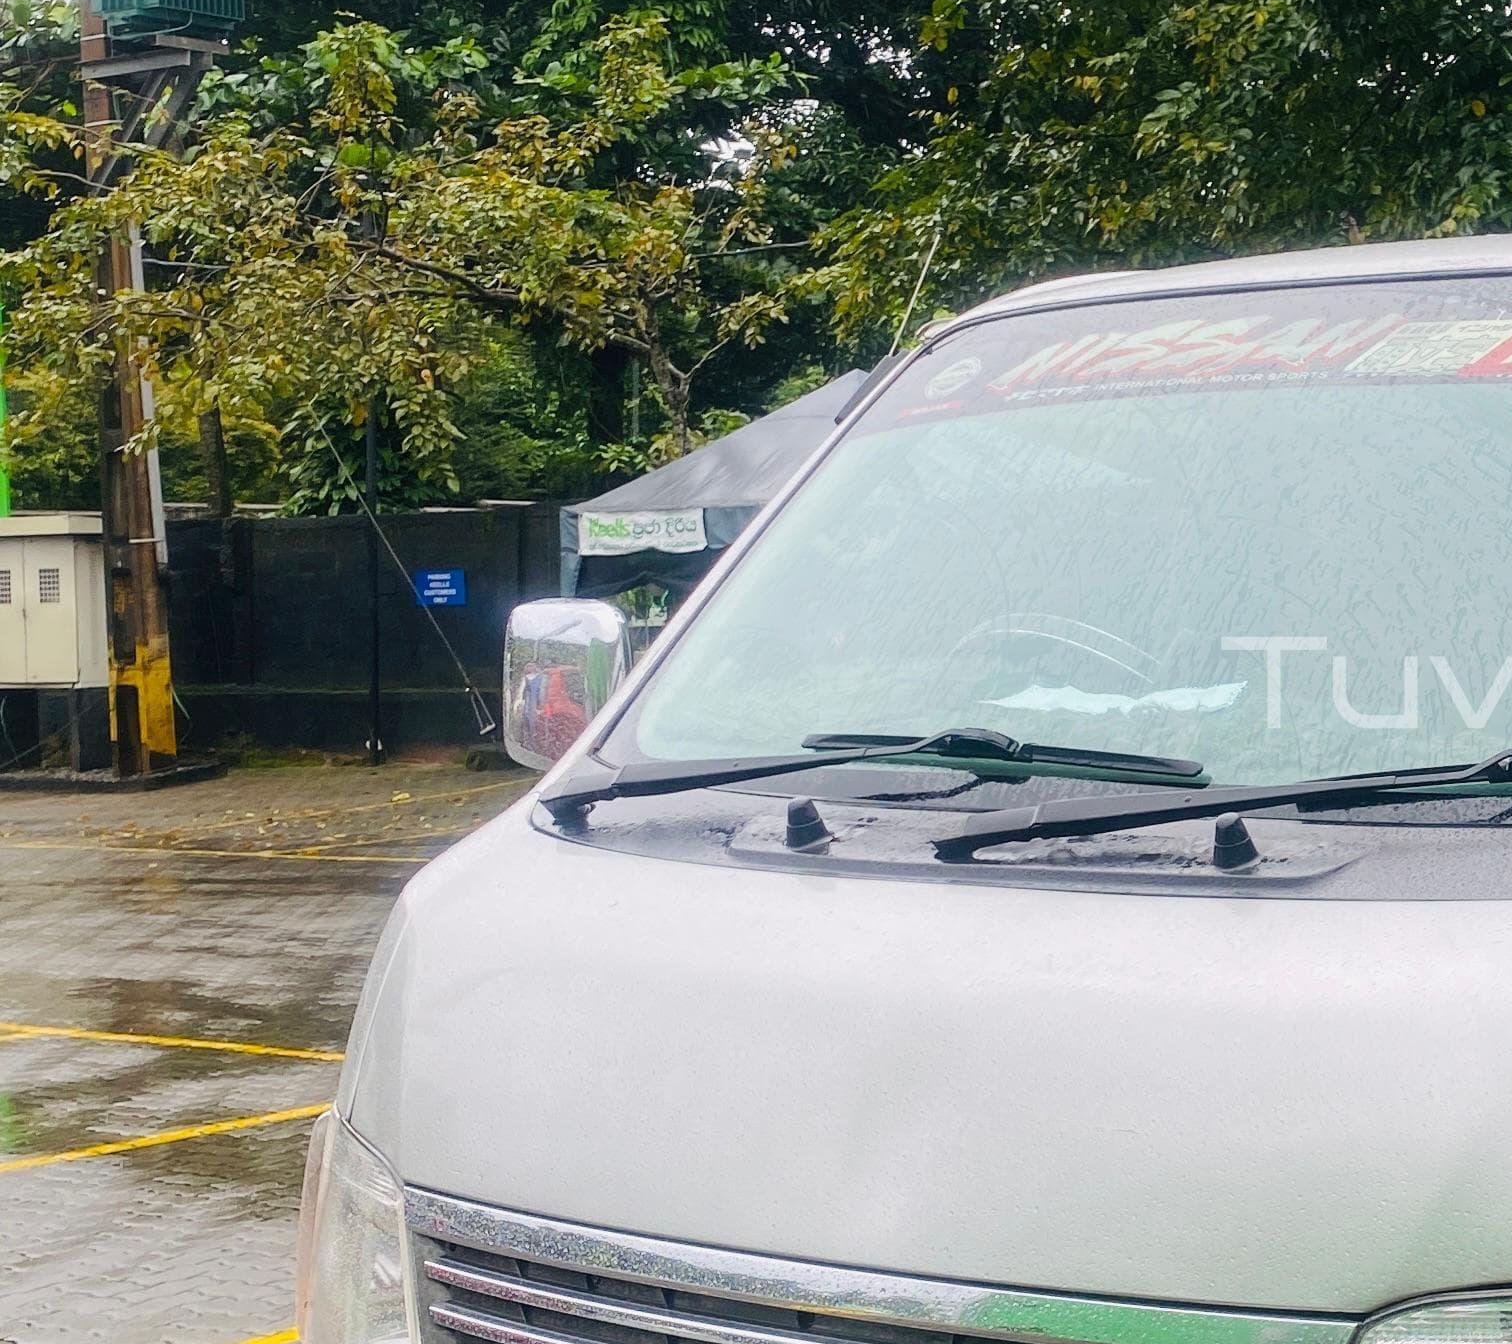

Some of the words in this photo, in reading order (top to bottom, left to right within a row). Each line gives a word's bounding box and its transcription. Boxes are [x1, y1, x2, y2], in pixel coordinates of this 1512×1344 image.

[985, 313, 1404, 395] NISSAN
[1095, 373, 1203, 391] INTERNATIONAL
[1209, 372, 1264, 383] MOTOR
[1267, 370, 1329, 382] SPORTS
